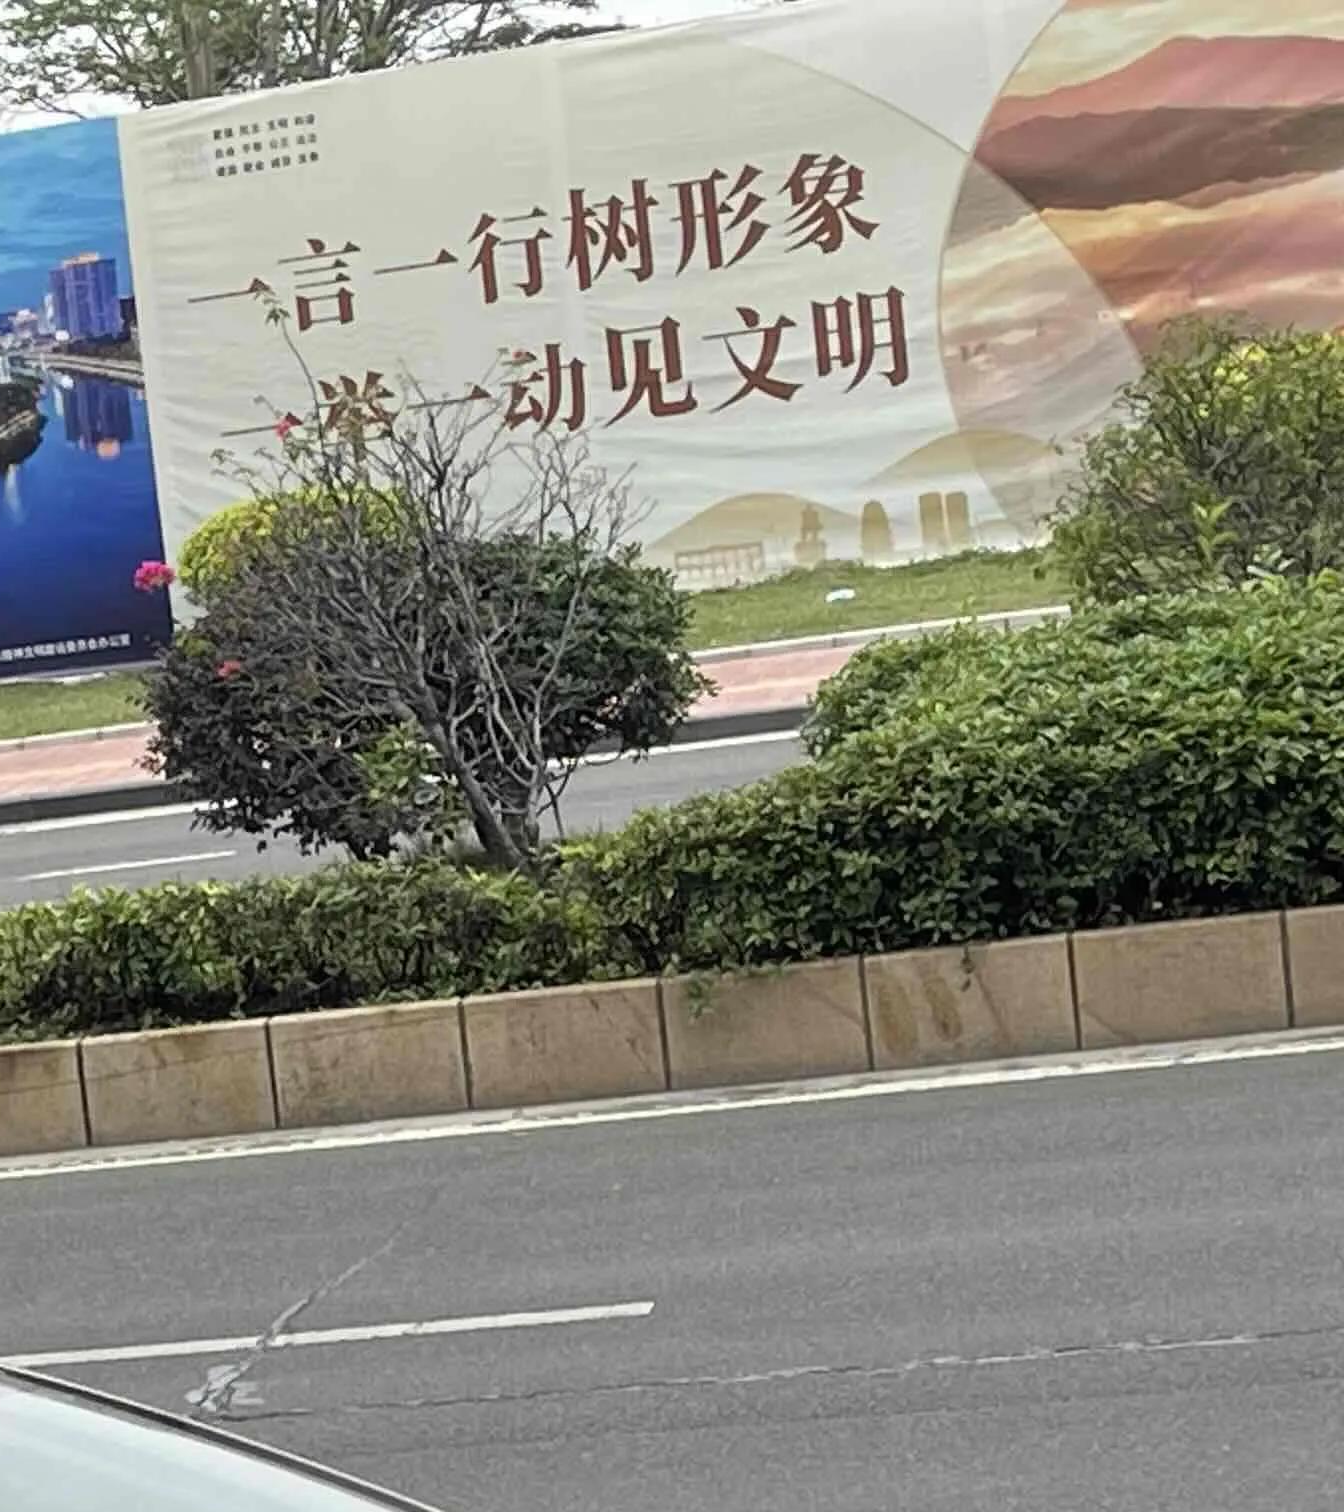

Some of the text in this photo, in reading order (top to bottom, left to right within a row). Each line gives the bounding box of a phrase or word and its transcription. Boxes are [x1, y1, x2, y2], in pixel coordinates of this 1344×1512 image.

[187, 152, 880, 332] 一言一行树形象
